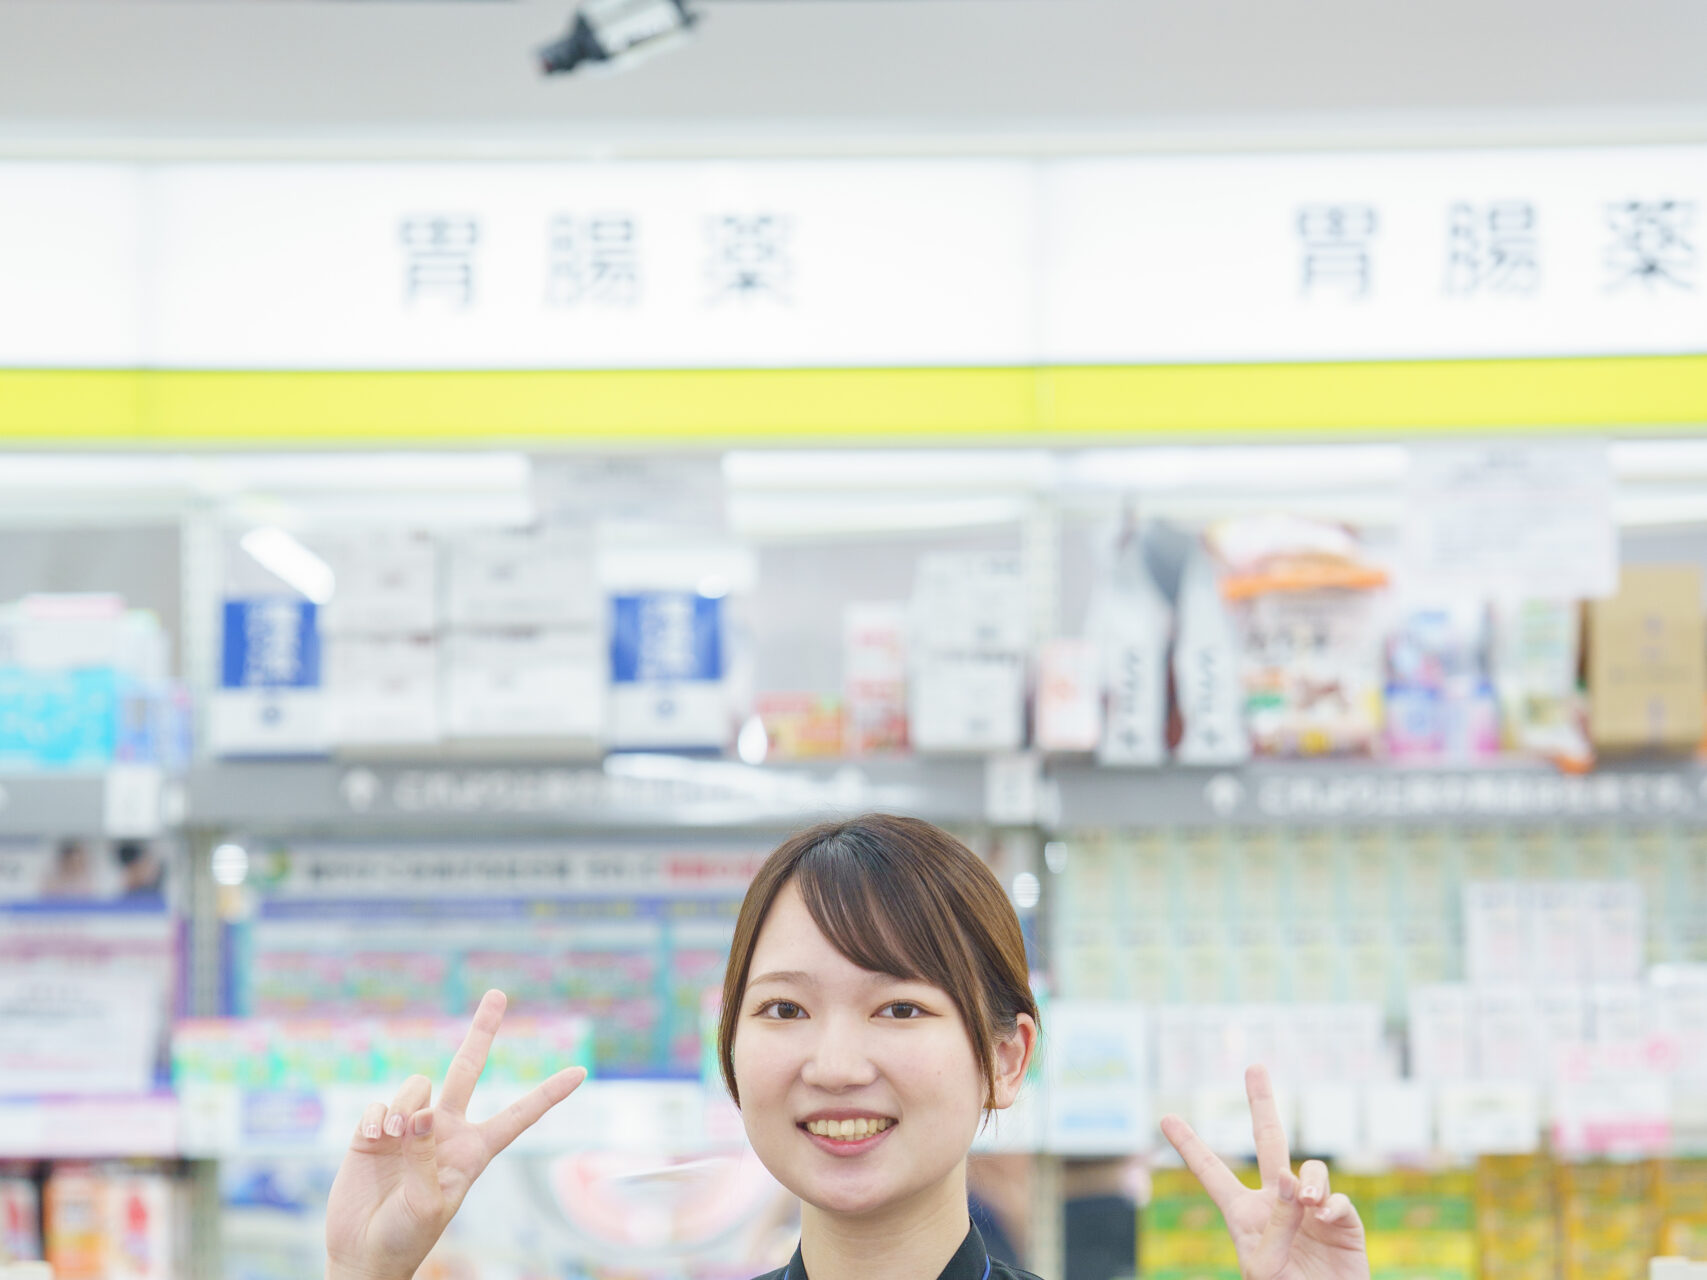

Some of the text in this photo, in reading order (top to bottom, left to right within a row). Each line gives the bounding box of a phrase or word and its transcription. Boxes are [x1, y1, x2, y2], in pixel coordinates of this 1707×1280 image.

[398, 213, 797, 308] 胃腸薬
[1295, 198, 1697, 297] 胃腸薬
